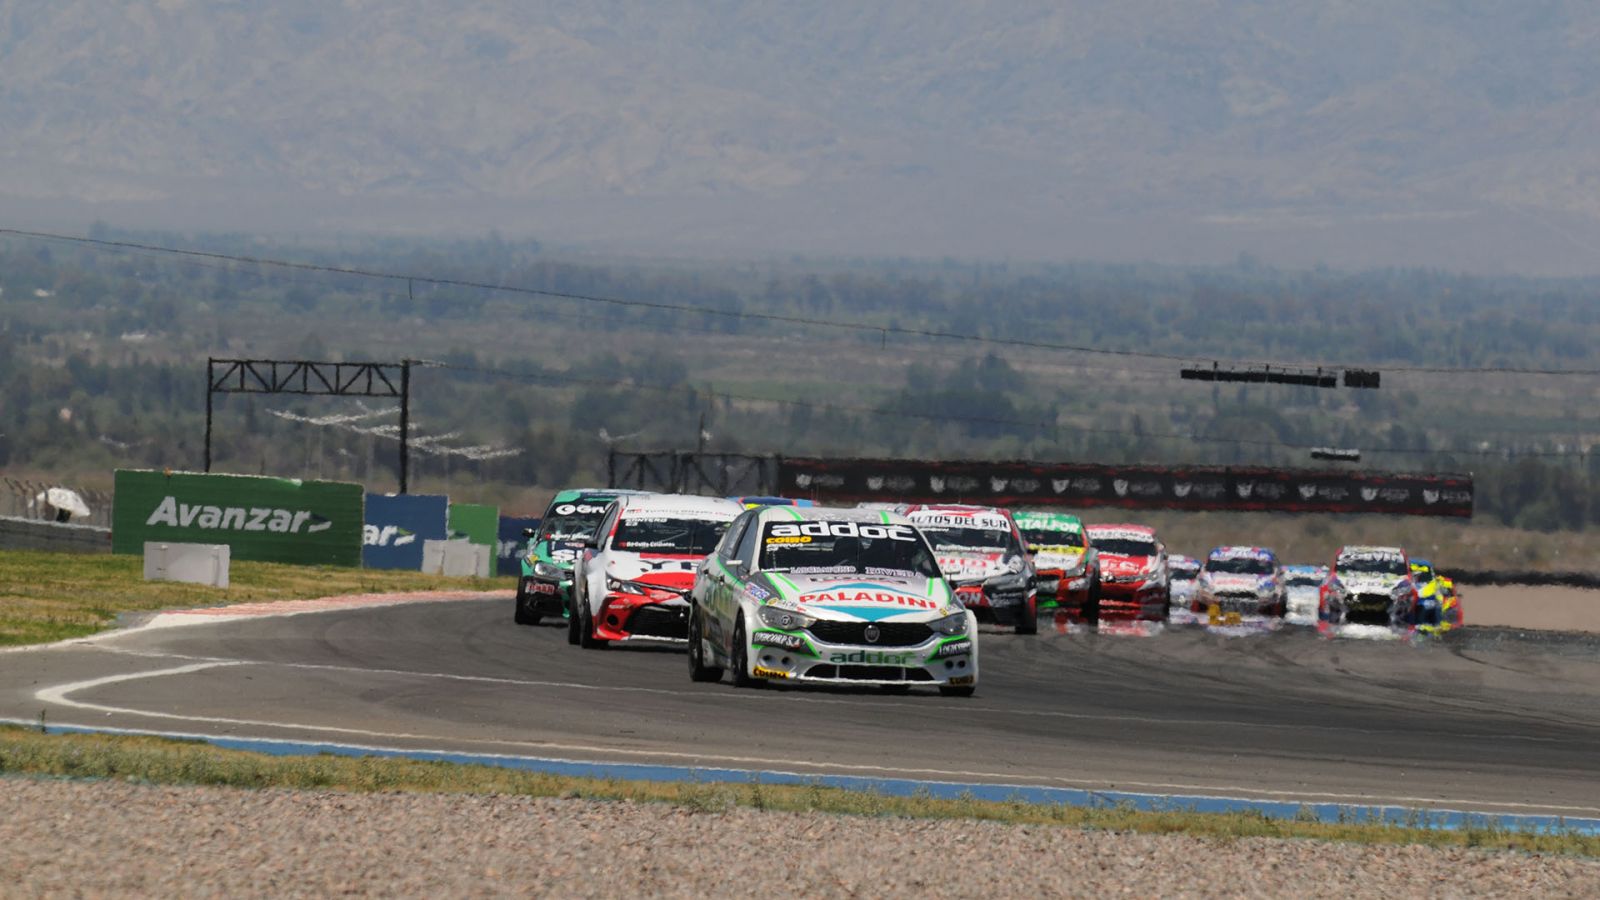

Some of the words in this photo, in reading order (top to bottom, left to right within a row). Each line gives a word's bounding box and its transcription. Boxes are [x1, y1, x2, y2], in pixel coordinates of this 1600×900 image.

[147, 496, 311, 533] Avanzar
[908, 514, 951, 525] AUTOS
[954, 516, 977, 526] DEL
[982, 518, 1008, 529] SUR
[799, 591, 937, 609] PALADINI
